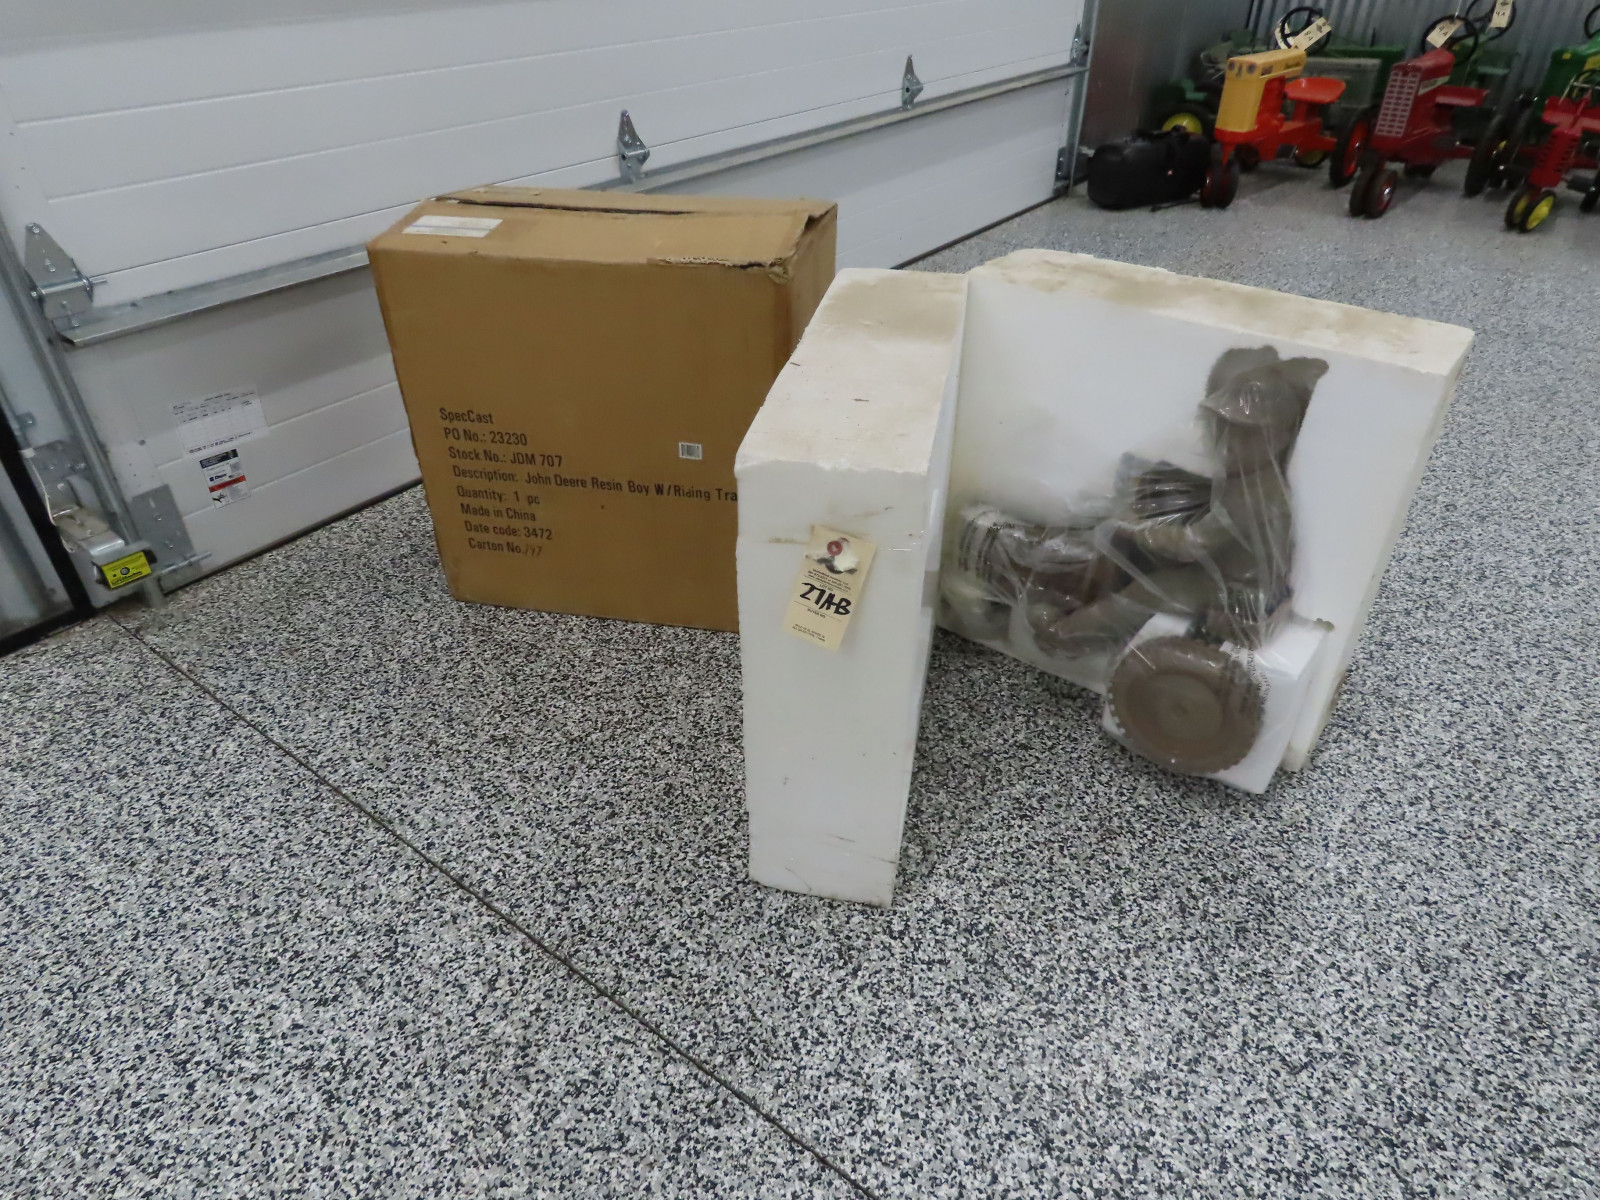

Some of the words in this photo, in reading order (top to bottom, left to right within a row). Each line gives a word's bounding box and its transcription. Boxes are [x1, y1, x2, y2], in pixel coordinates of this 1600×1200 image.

[439, 407, 494, 424] SpecCast
[444, 427, 461, 440] PO
[463, 428, 487, 442] No.:
[489, 430, 528, 446] 23230
[448, 446, 481, 461] Stock
[483, 449, 507, 463] No.:
[510, 452, 536, 465] JDM
[539, 454, 562, 467] 707
[453, 464, 518, 483] Description:
[525, 472, 552, 485] John
[554, 474, 587, 488] Deere
[591, 476, 623, 492] Resin
[627, 480, 650, 496] Boy
[457, 485, 507, 503] Quantity:
[513, 490, 520, 502] 1
[527, 495, 540, 506] pc
[460, 503, 491, 517] Made
[493, 507, 503, 518] in
[505, 507, 536, 522] China
[464, 520, 490, 534] Date
[493, 525, 522, 537] code:
[523, 526, 553, 541] 3472
[468, 538, 504, 552] Carton
